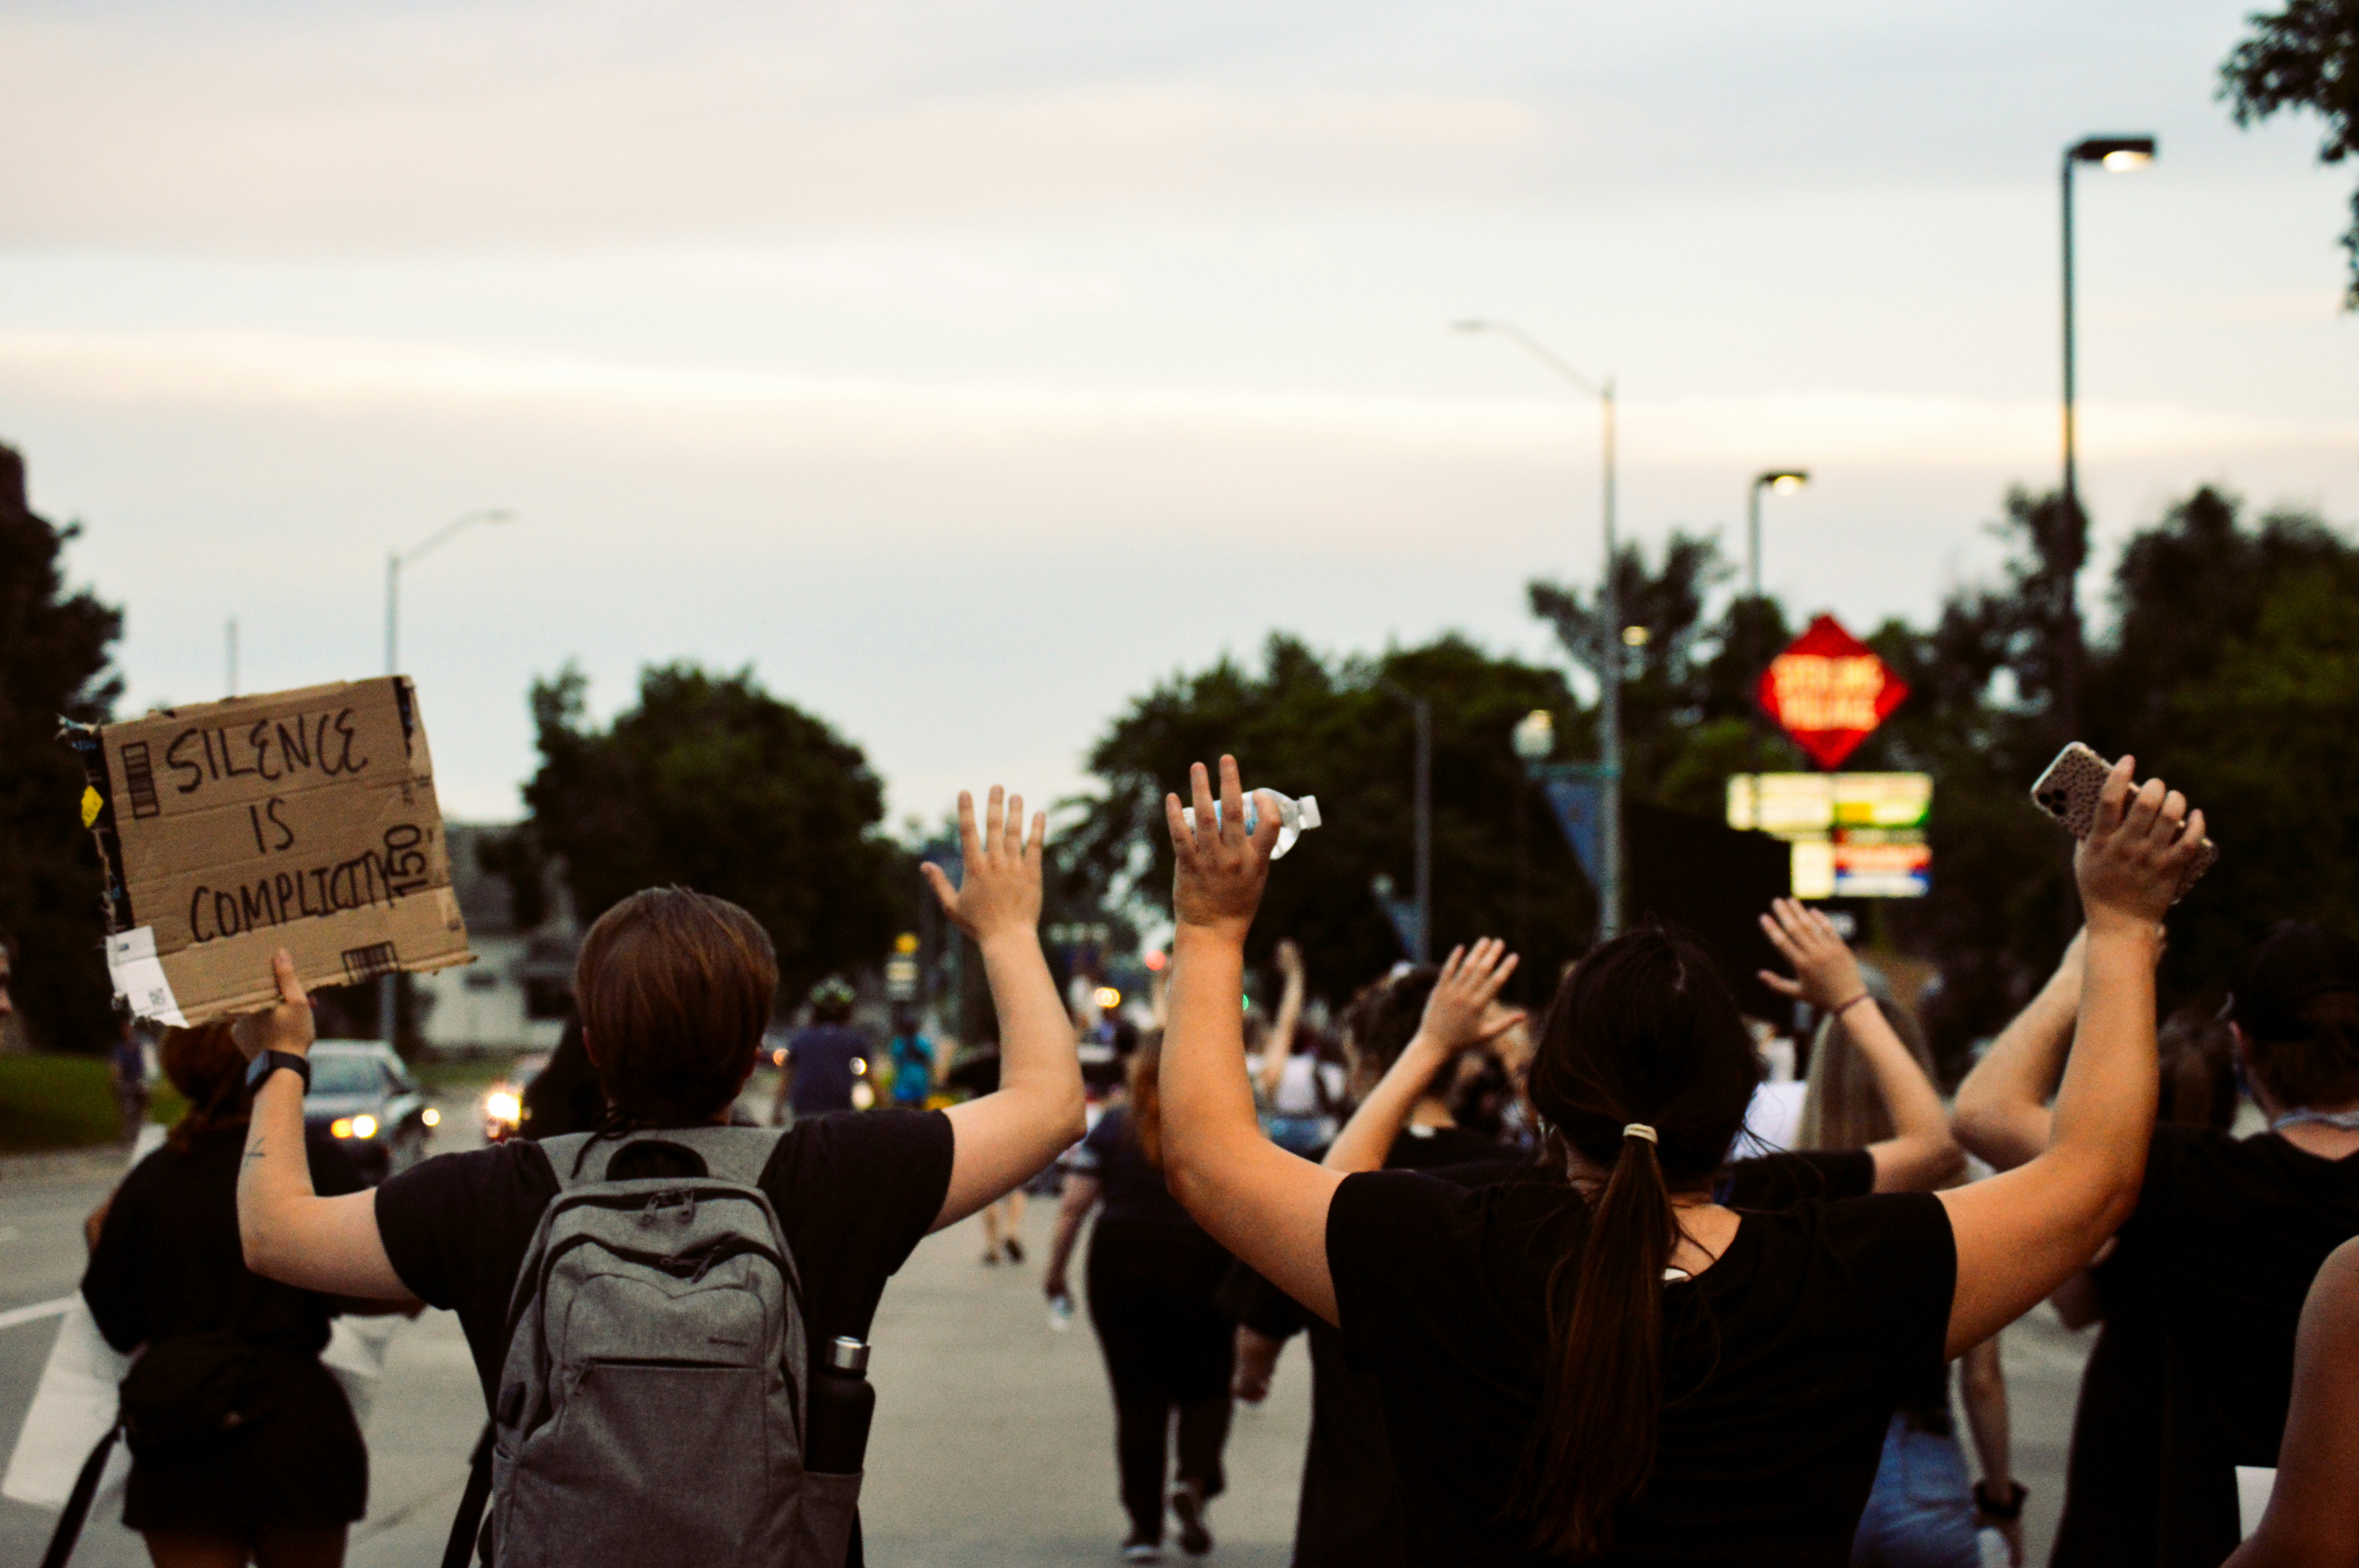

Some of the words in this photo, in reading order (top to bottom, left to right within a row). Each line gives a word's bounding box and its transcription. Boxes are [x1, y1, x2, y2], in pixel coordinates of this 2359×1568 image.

[166, 708, 368, 793] SILENCE
[249, 797, 294, 854] IS
[384, 824, 428, 898] 150
[190, 849, 394, 943] COMPLICITY
